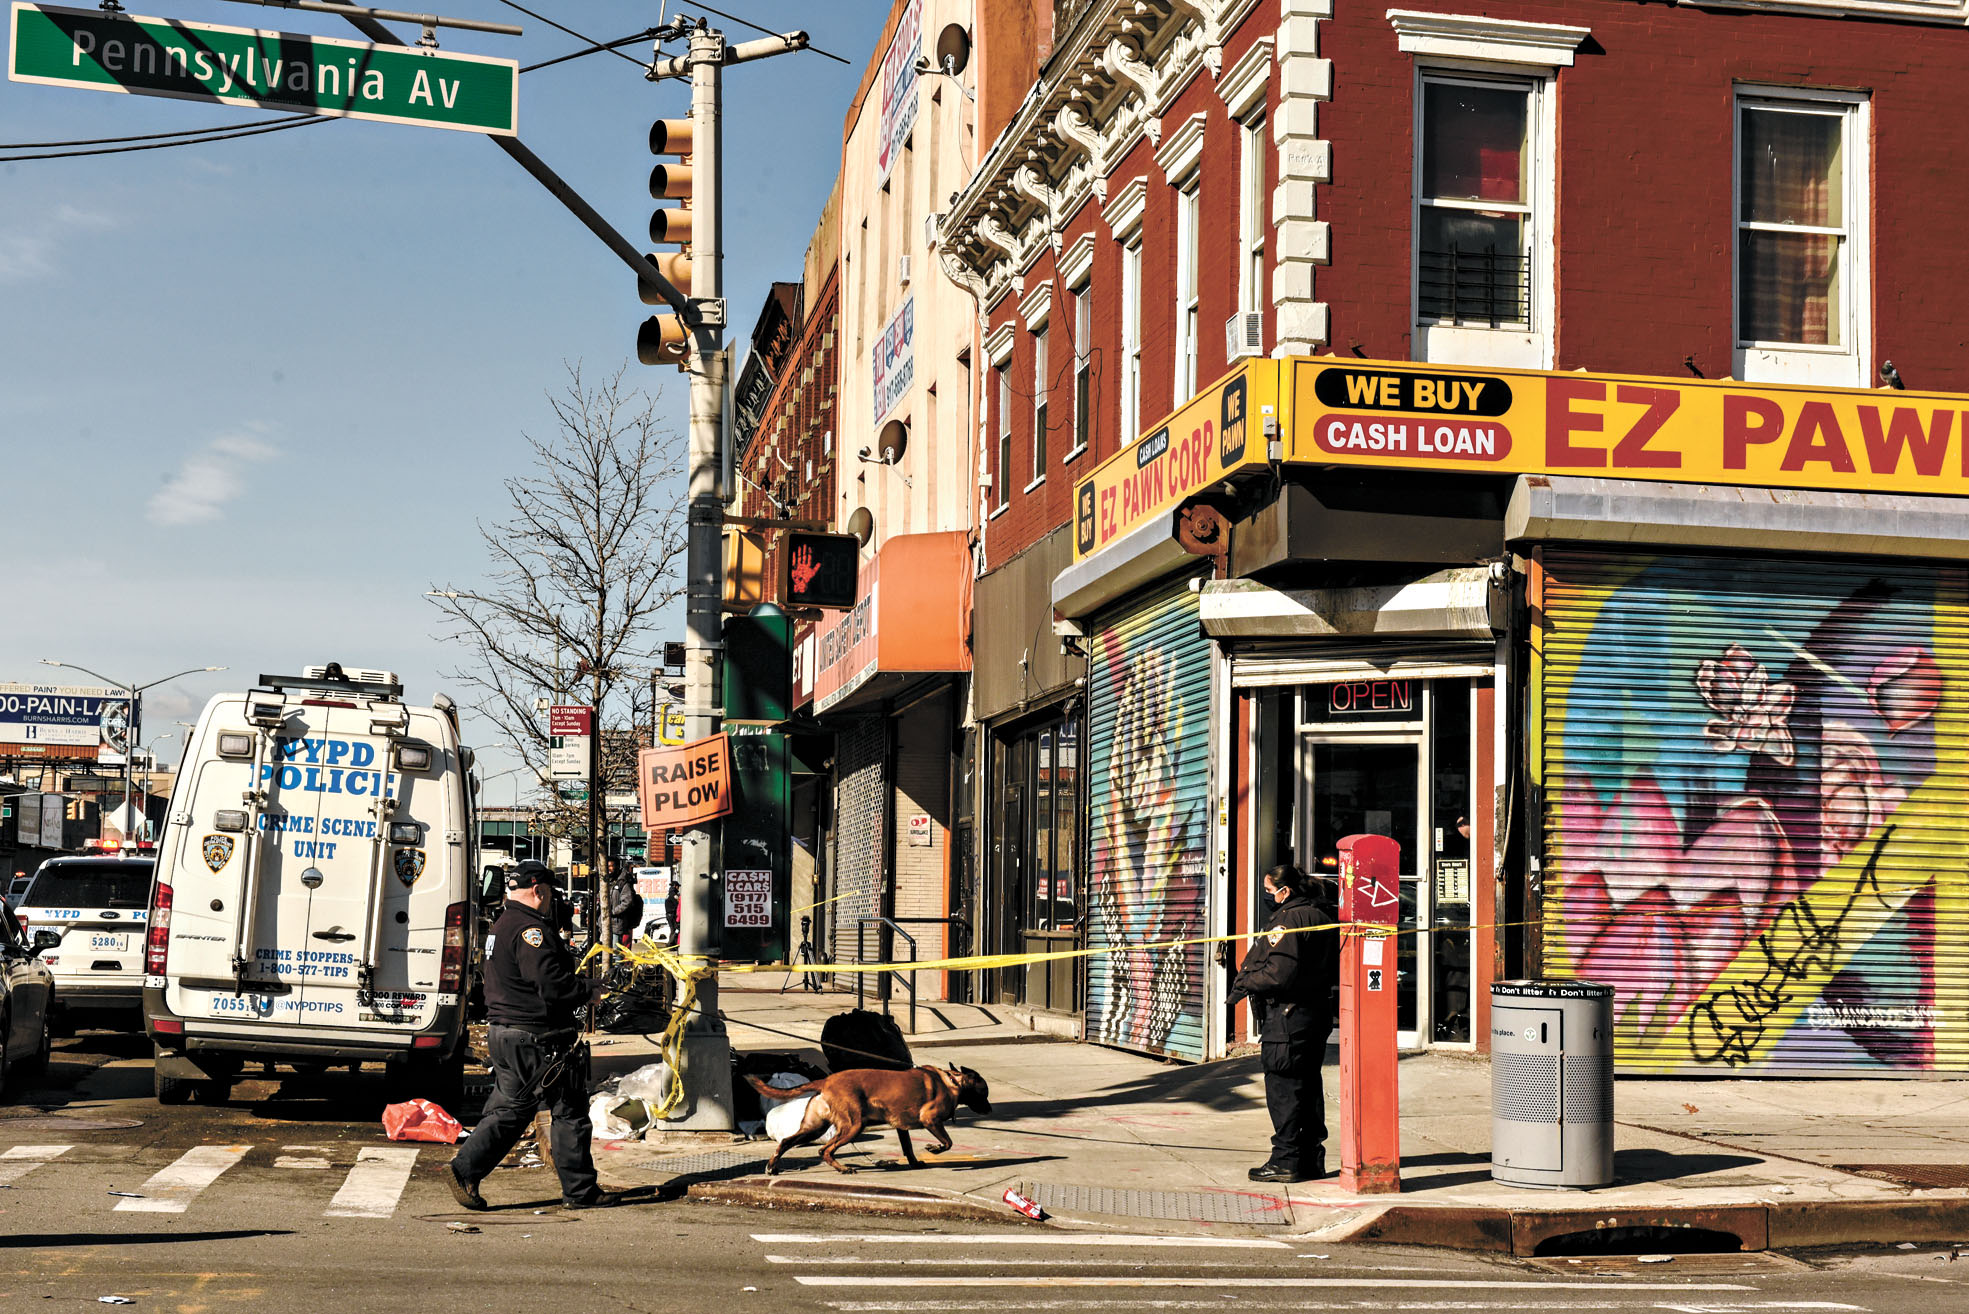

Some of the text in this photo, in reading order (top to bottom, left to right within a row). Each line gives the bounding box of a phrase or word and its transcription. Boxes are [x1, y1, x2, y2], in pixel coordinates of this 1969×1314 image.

[72, 29, 460, 109] Pennsylvania Av
[1345, 374, 1486, 411] WE BUY
[1227, 389, 1241, 423] WE
[1222, 418, 1245, 458] PAWN
[1327, 421, 1495, 455] CASH LOAN
[1545, 377, 1969, 478] EZ PAW
[1139, 431, 1167, 465] CASH LOANS
[1101, 419, 1214, 545] EZ PAWN CORP
[1081, 491, 1092, 517] WE
[1080, 517, 1093, 545] BUY
[33, 686, 57, 694] PAIN?
[60, 687, 78, 695] YOU
[80, 688, 103, 696] NEED
[104, 689, 126, 697] LAW!
[1333, 681, 1408, 710] OPEN
[23, 715, 89, 724] BURNSHARRIS.COM
[274, 736, 375, 767] NYPD
[555, 736, 560, 748] 1
[248, 763, 395, 798] POLICE
[651, 752, 720, 785] RAISE
[655, 780, 719, 812] PLOW
[258, 813, 377, 838] CRIME SCENE
[294, 840, 337, 860] UNIT
[636, 878, 668, 894] FREE
[729, 893, 768, 903] (917)
[727, 914, 770, 925] 6499
[733, 903, 764, 914] 515
[175, 933, 227, 943] SPRINTER
[256, 948, 354, 964] CRIME STOPPERS
[260, 962, 348, 978] 1-800-577-TIPS
[1501, 985, 1521, 995] Don't
[1522, 986, 1544, 996] litter
[1560, 989, 1584, 997] Don't
[1586, 989, 1603, 997] litter
[213, 997, 245, 1011] 7055
[275, 1000, 344, 1014] @NYPDTIPS
